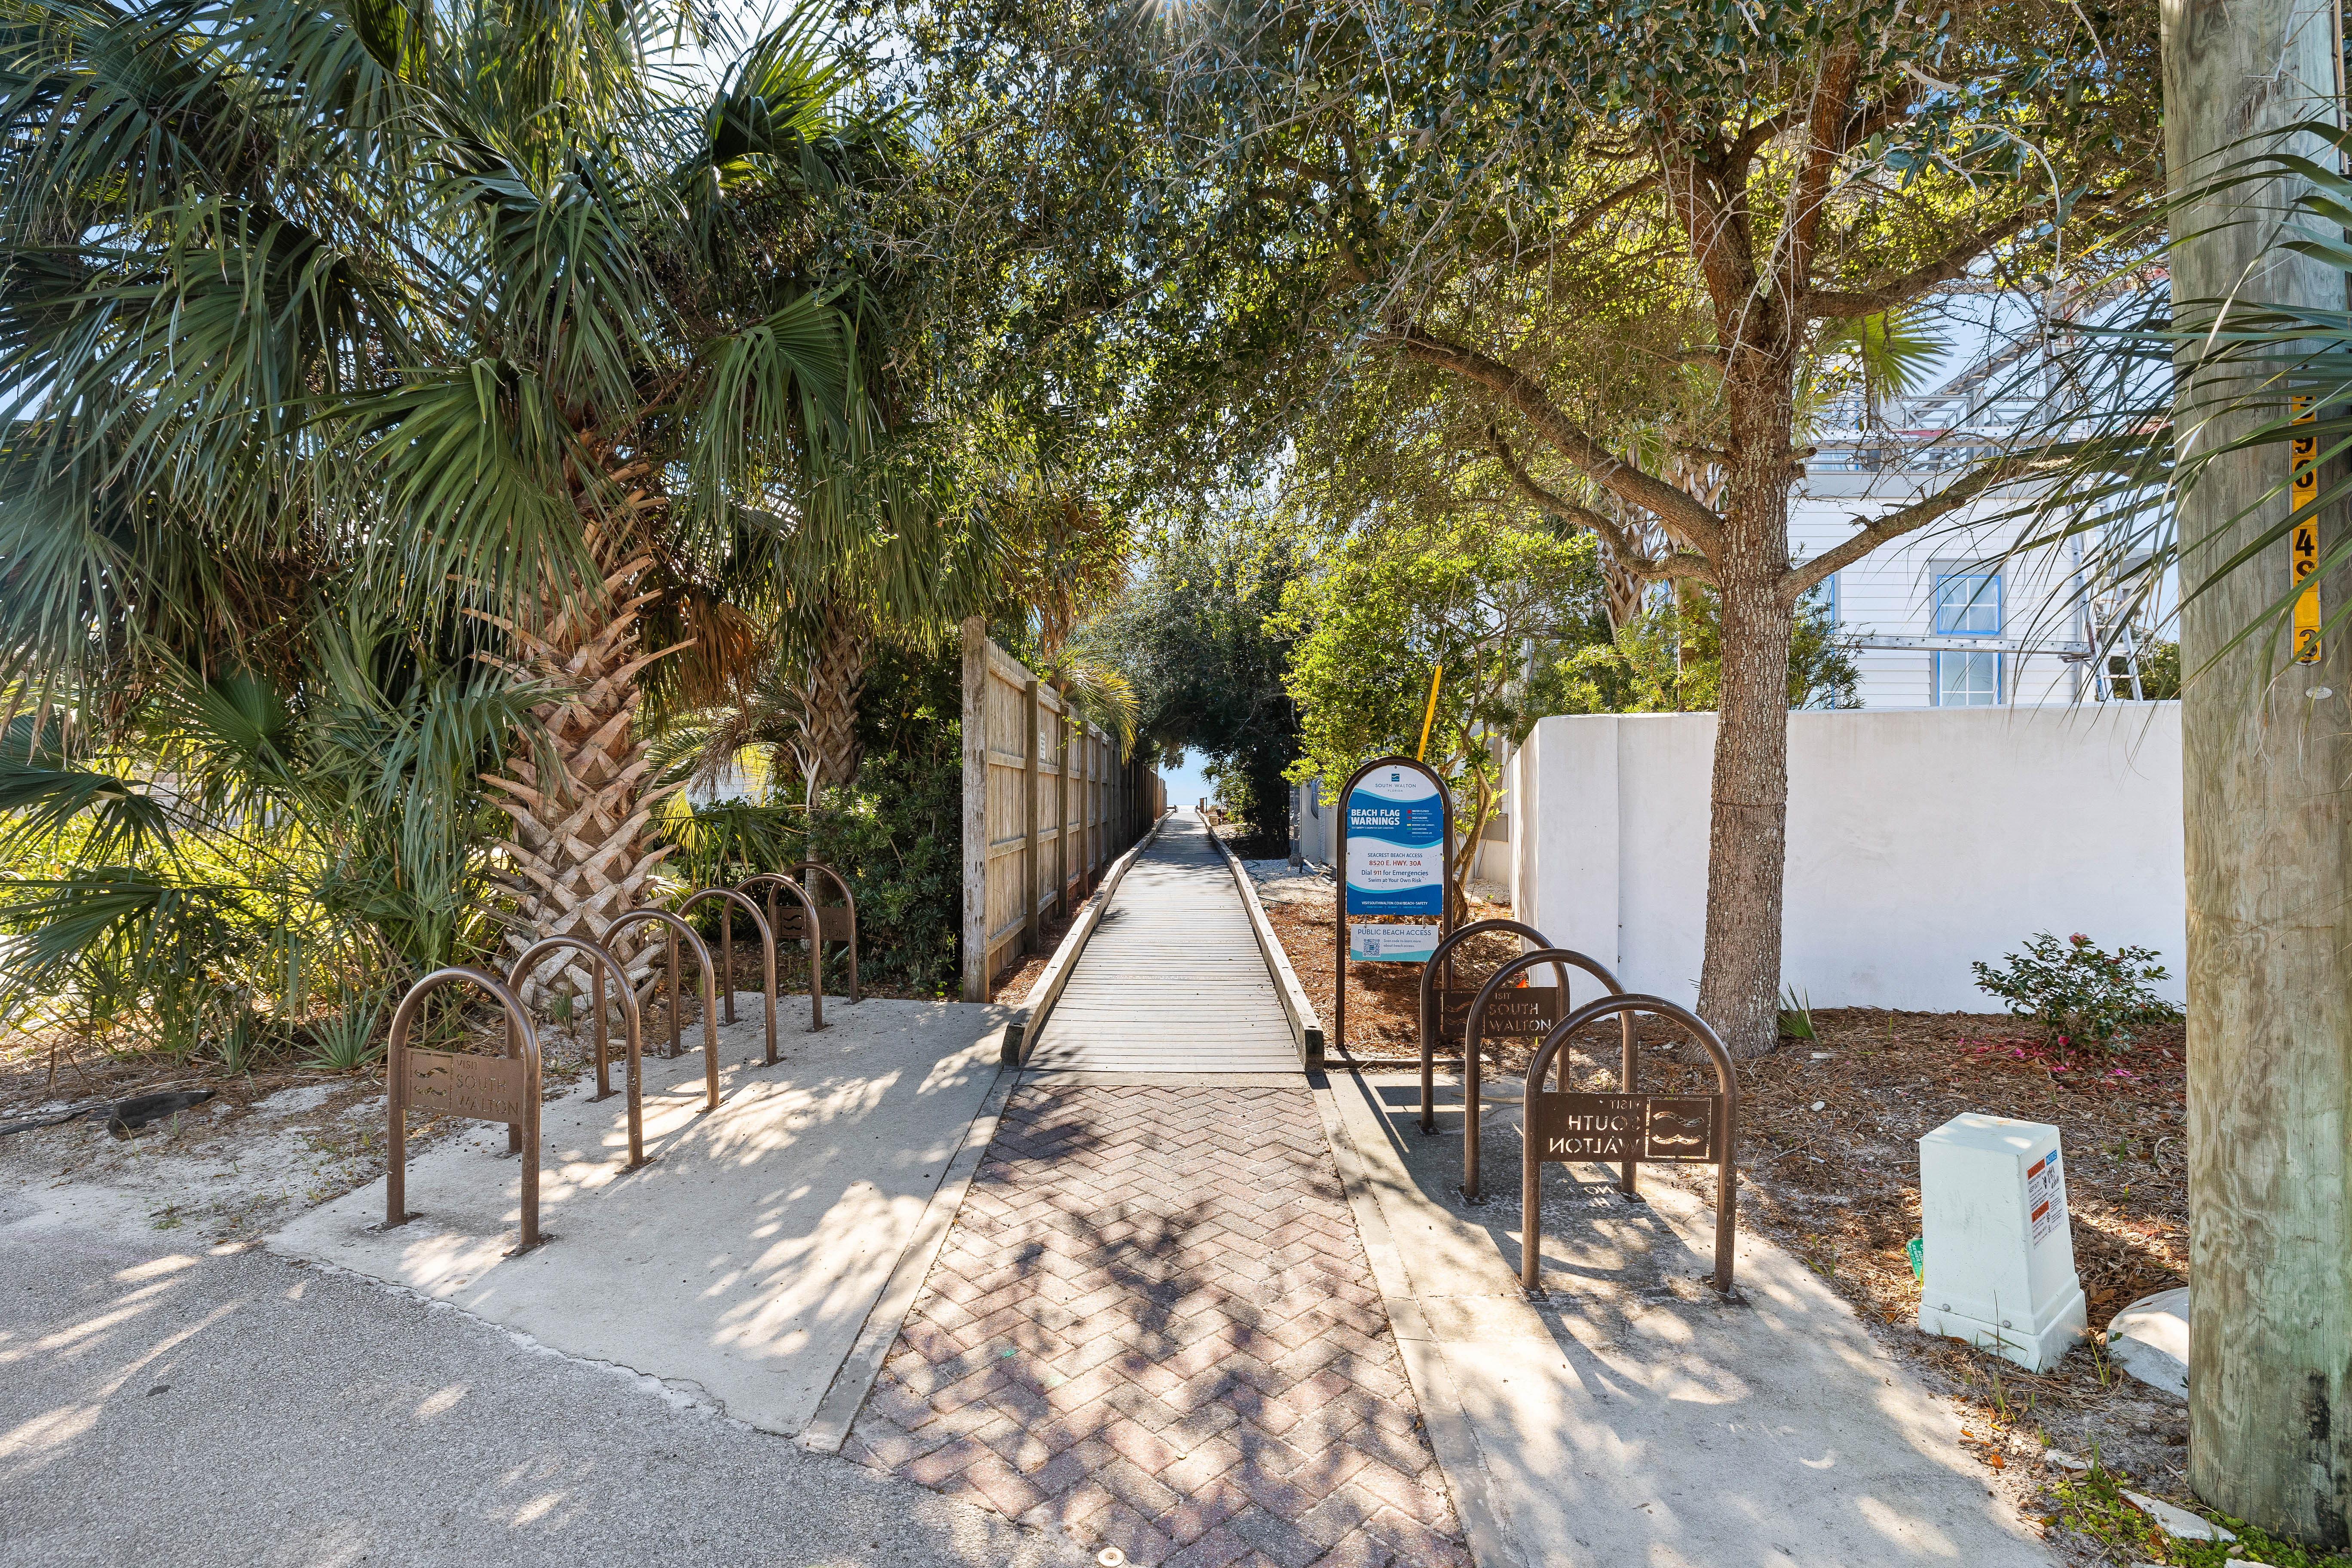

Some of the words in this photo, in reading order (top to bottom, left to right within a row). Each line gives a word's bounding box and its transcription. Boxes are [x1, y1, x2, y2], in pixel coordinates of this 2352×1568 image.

[1351, 817, 1400, 825] WARNINGS
[1489, 1003, 1538, 1016] SOUTH
[1489, 1019, 1551, 1032] WALTON
[456, 1059, 478, 1070] VISIT
[456, 1074, 506, 1093] SOUTH
[456, 1095, 519, 1116] WALTON
[2046, 1151, 2056, 1163] NOTICE
